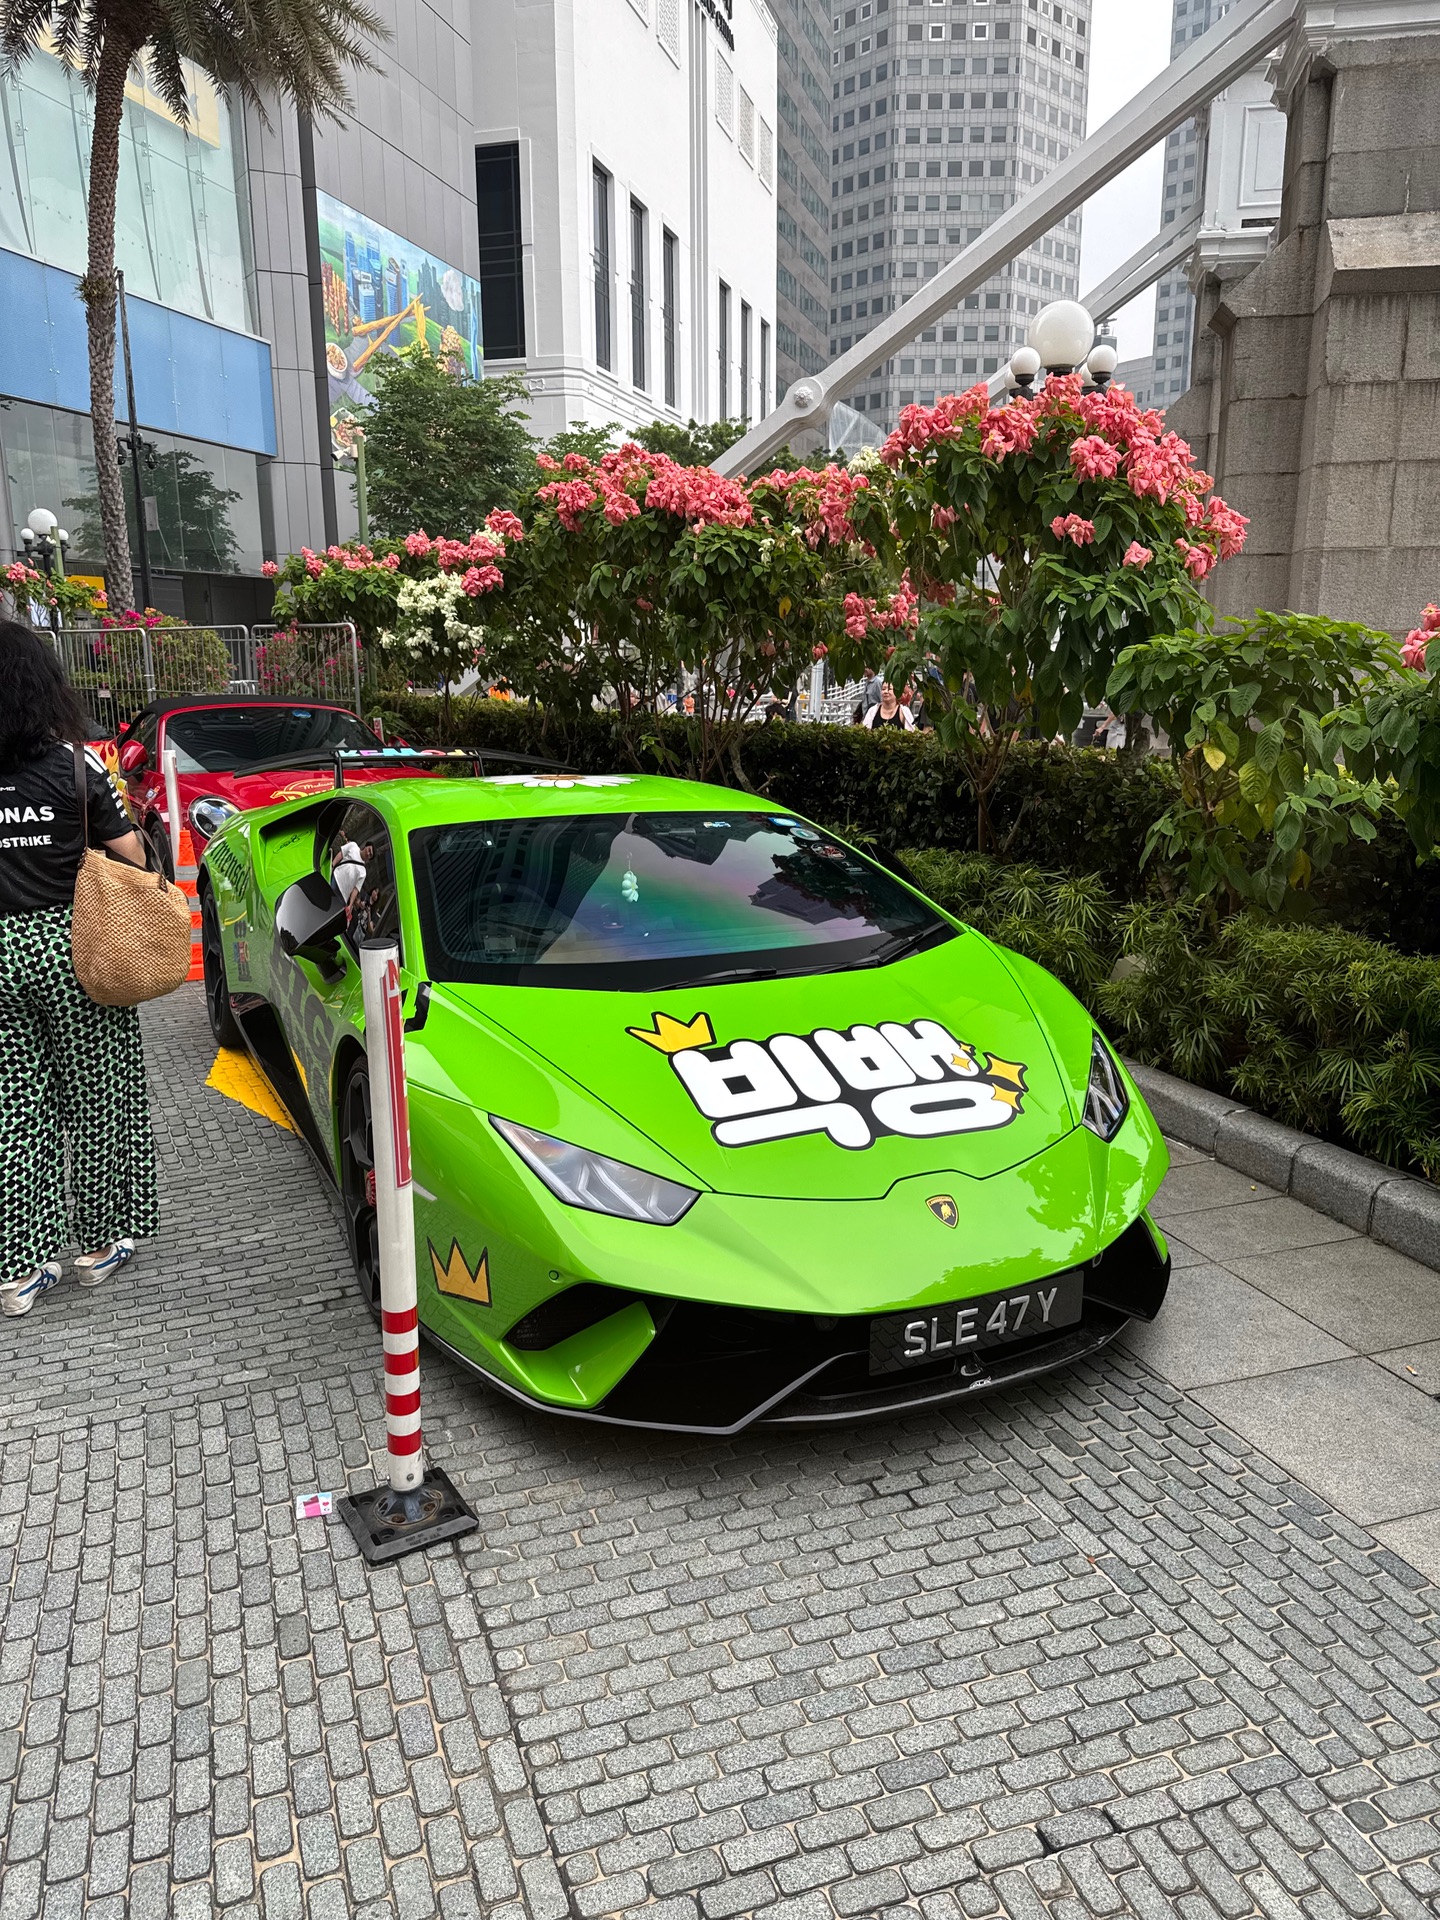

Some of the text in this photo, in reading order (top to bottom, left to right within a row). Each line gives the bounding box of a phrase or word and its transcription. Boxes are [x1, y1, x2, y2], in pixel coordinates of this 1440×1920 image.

[0, 834, 53, 849] STRIKE
[669, 1019, 1017, 1150] 빅뱅
[903, 1307, 979, 1358] SLE
